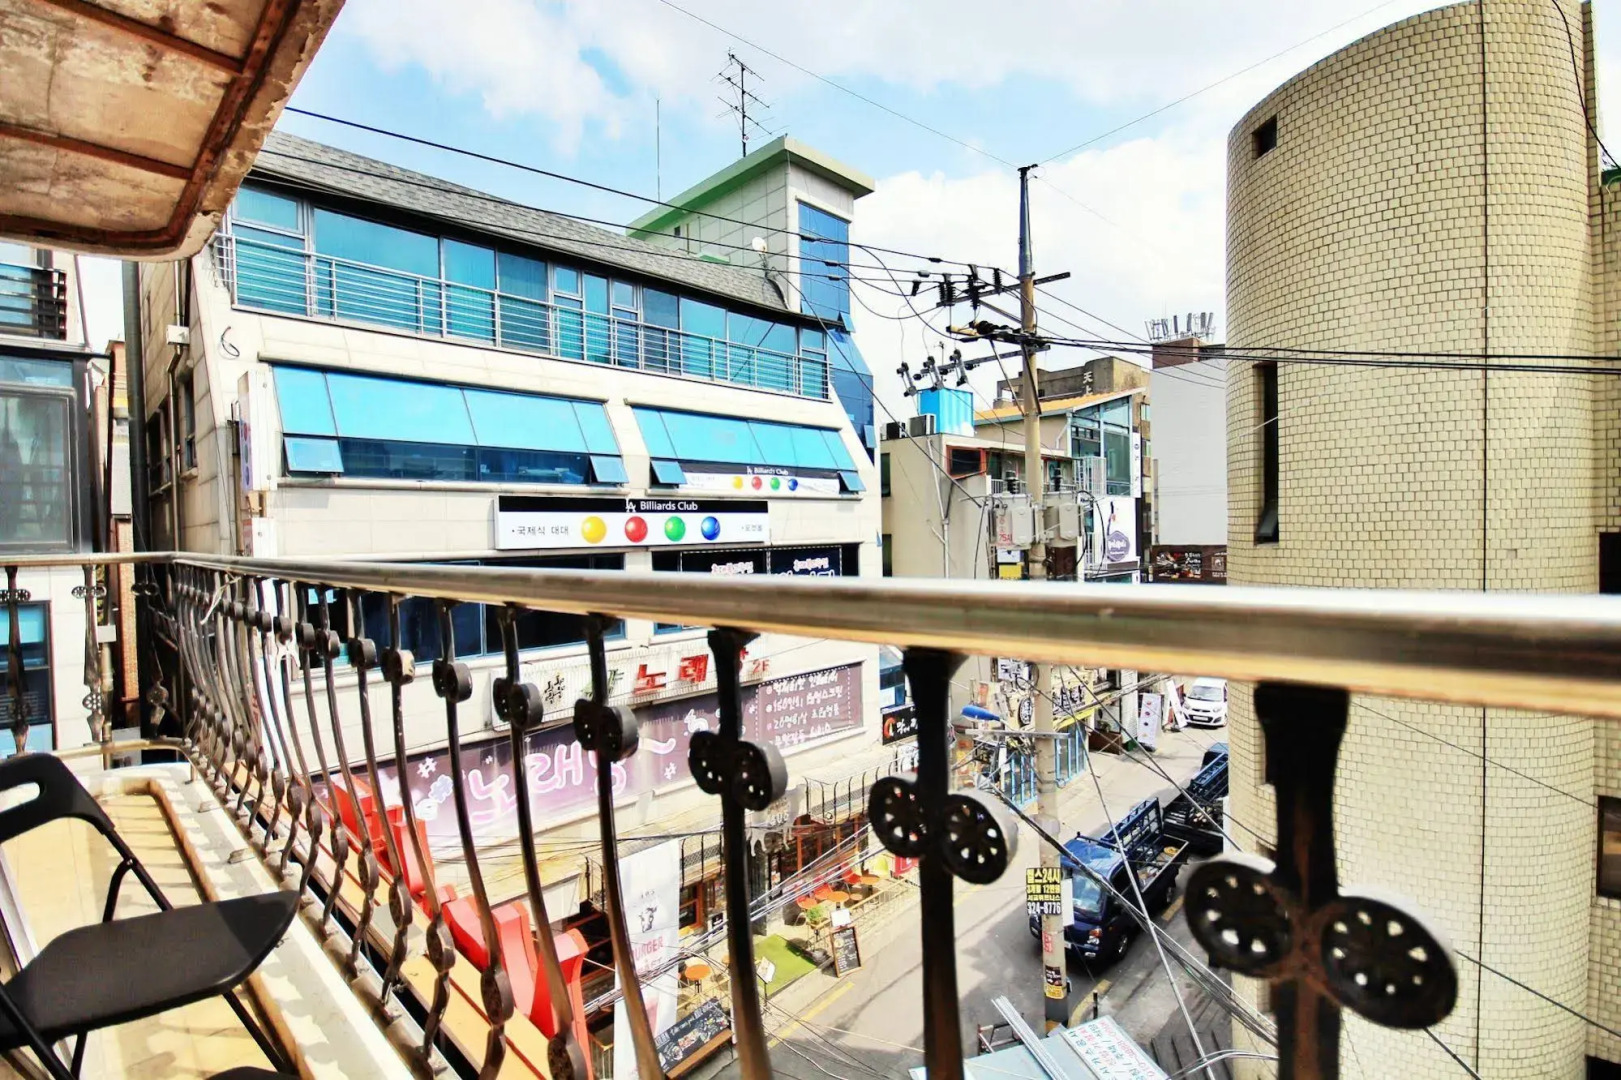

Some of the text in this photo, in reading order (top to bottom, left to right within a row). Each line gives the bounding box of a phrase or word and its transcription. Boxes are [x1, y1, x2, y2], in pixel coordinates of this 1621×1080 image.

[776, 468, 789, 476] Club
[640, 501, 676, 510] Billiards
[677, 501, 698, 510] Club
[517, 525, 546, 536] 국제식
[753, 659, 770, 674] 2F
